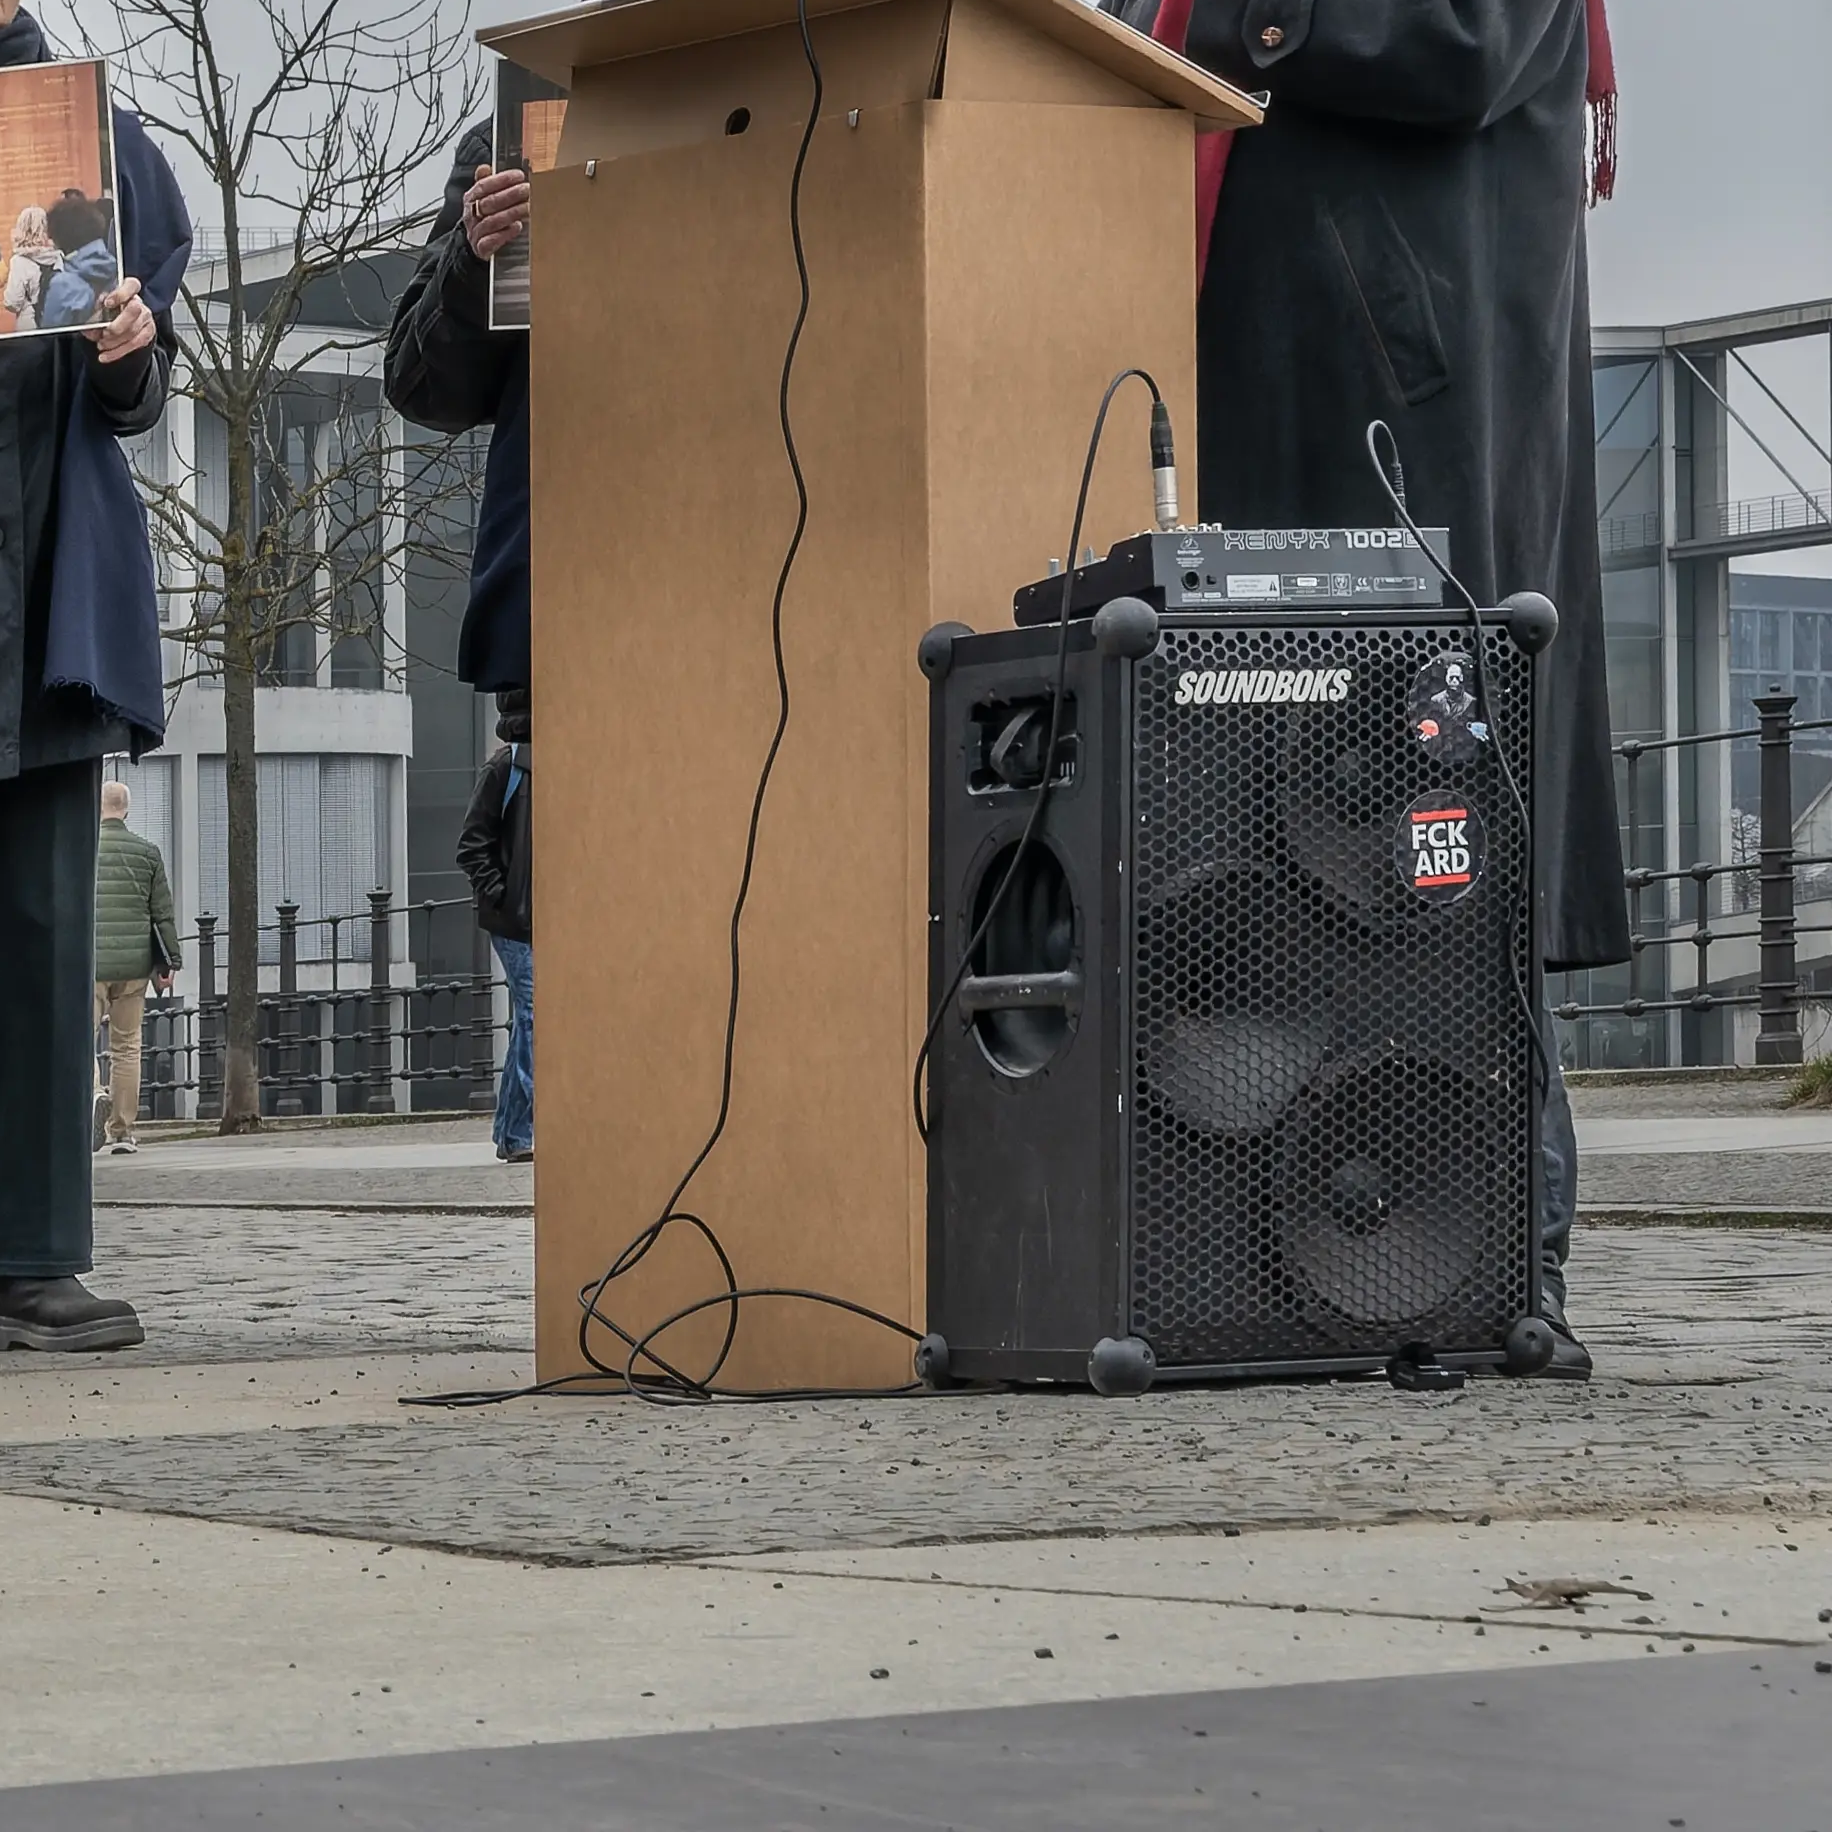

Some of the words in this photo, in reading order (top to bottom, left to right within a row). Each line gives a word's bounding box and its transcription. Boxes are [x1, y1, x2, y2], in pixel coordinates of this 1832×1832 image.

[1224, 531, 1330, 550] XENYX
[1175, 668, 1352, 705] SOUNDBOKS
[1411, 820, 1469, 850] FCK
[1414, 848, 1471, 877] ARD
